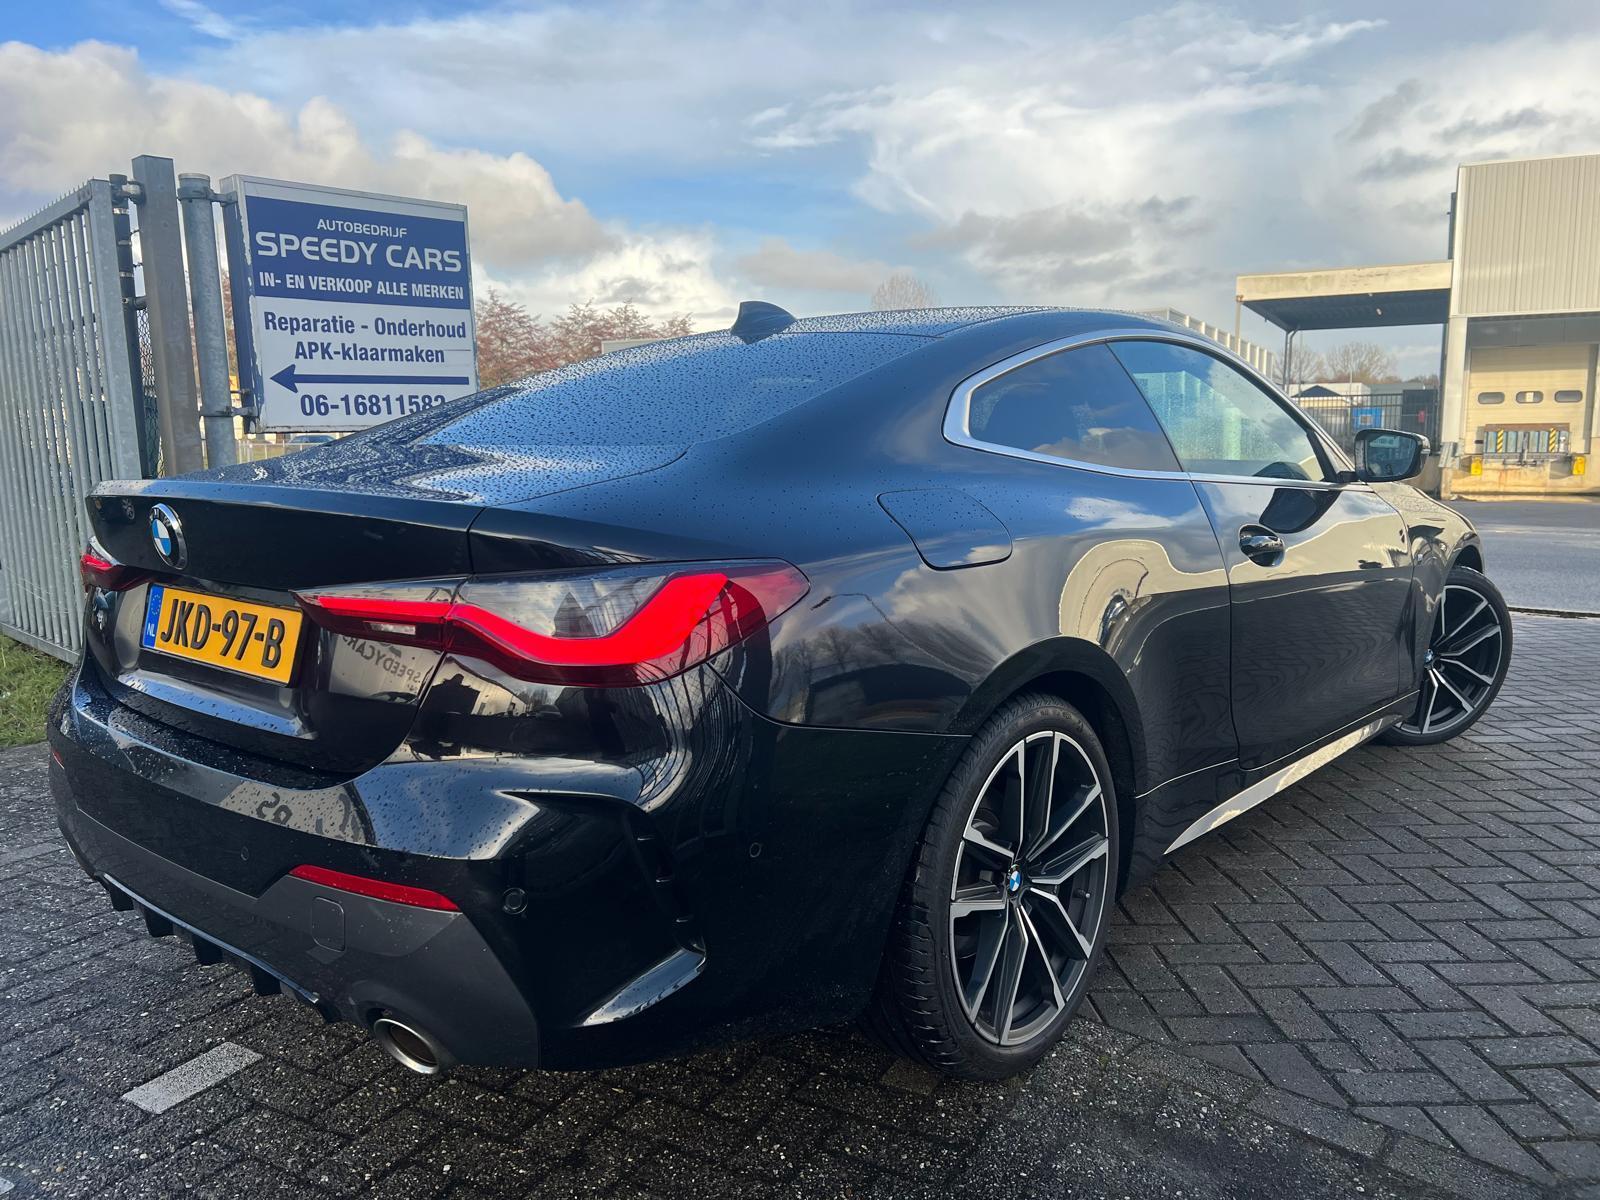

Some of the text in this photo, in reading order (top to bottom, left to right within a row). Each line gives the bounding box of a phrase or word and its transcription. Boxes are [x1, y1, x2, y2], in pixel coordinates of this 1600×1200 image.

[316, 218, 407, 238] AUTOBEDRIJF
[255, 231, 462, 273] SPEEDY CARS
[259, 271, 464, 300] IN- EN VERKOOP ALLE MERKEN
[263, 311, 355, 335] Reparatie
[374, 317, 466, 339] Onderhoud
[294, 341, 445, 363] APK-klaarmaken
[146, 622, 155, 637] NL
[160, 598, 285, 669] JKD-97-B
